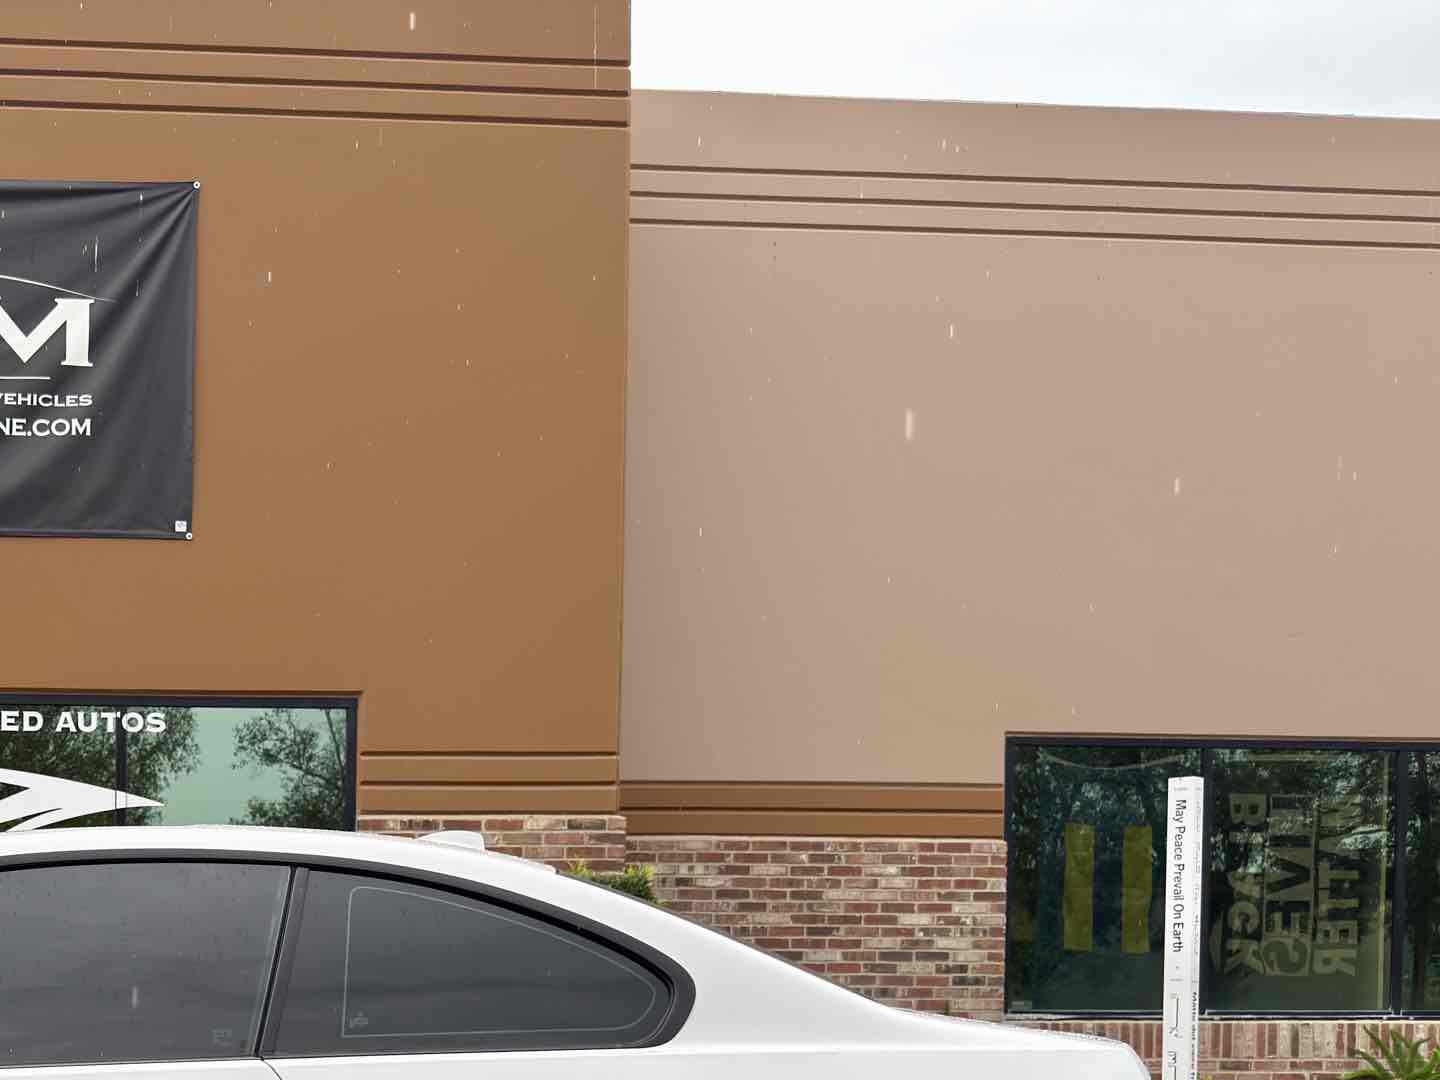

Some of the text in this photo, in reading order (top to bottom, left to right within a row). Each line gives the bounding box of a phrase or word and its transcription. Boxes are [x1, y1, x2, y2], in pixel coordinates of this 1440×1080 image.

[55, 711, 167, 734] AUTOS
[1172, 799, 1187, 823] May
[1173, 826, 1186, 861] Peace
[1172, 863, 1185, 901] Prevail
[1172, 903, 1184, 919] On
[1172, 922, 1184, 953] Earth
